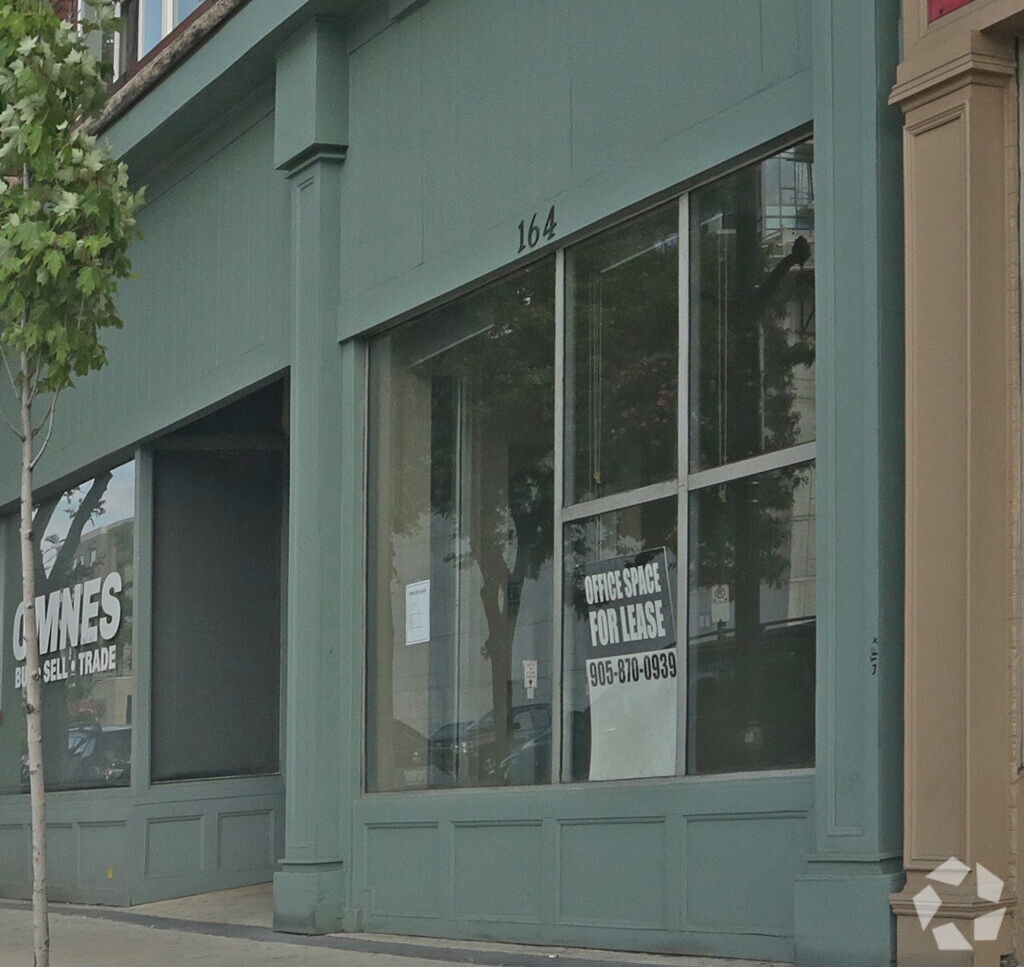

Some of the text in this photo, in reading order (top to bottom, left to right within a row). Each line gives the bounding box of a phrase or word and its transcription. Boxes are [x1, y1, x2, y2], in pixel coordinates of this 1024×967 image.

[517, 204, 557, 253] 164
[584, 562, 661, 605] OFFICE SPACE
[589, 599, 666, 647] FOR LEASE
[43, 656, 68, 683] SELL
[78, 645, 116, 676] TRADE
[589, 651, 677, 687] 905-870-0939
